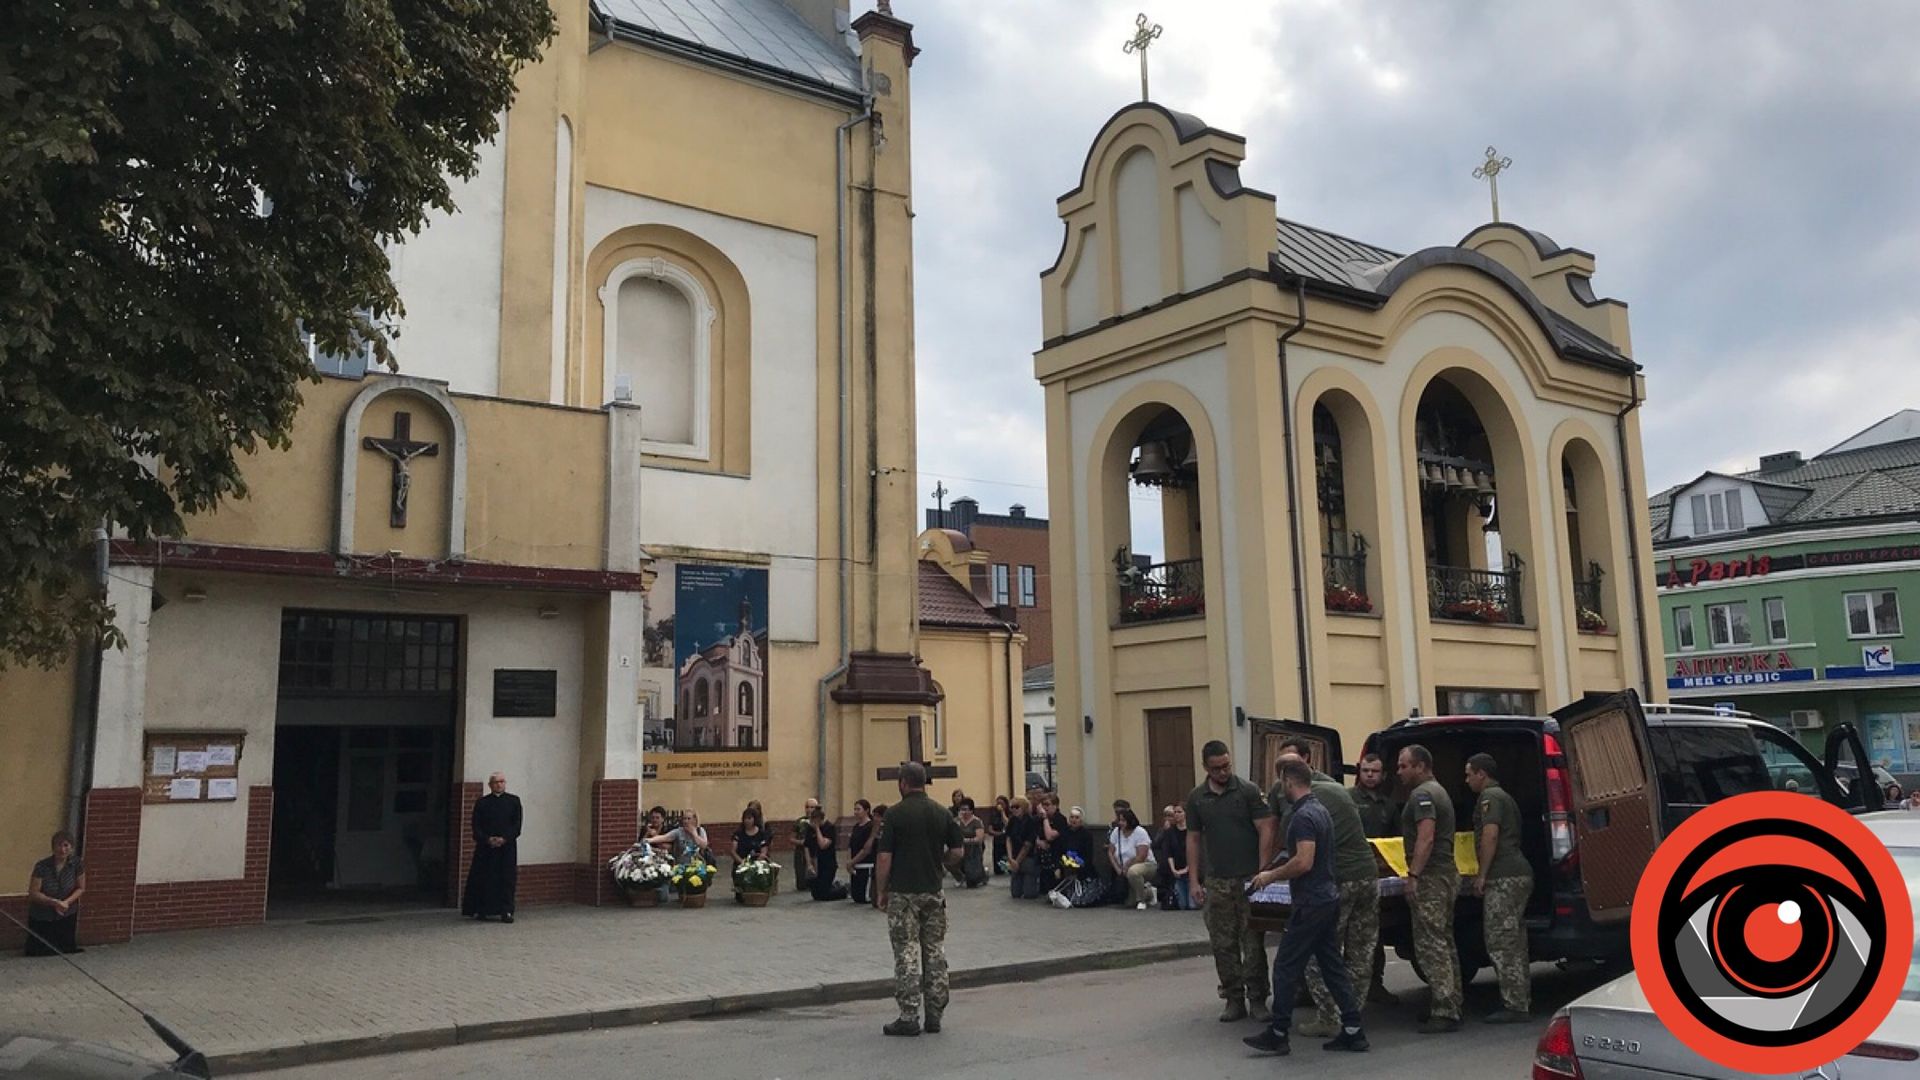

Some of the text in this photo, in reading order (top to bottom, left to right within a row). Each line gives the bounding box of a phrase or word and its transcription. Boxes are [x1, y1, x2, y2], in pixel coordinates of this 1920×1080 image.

[1808, 551, 1864, 564] САЛОН
[1690, 553, 1772, 586] Paris
[1674, 649, 1794, 677] АПТЕКА
[1684, 677, 1715, 687] МЕД
[1724, 672, 1781, 684] СЕРВІС
[1598, 1036, 1641, 1055] 220
